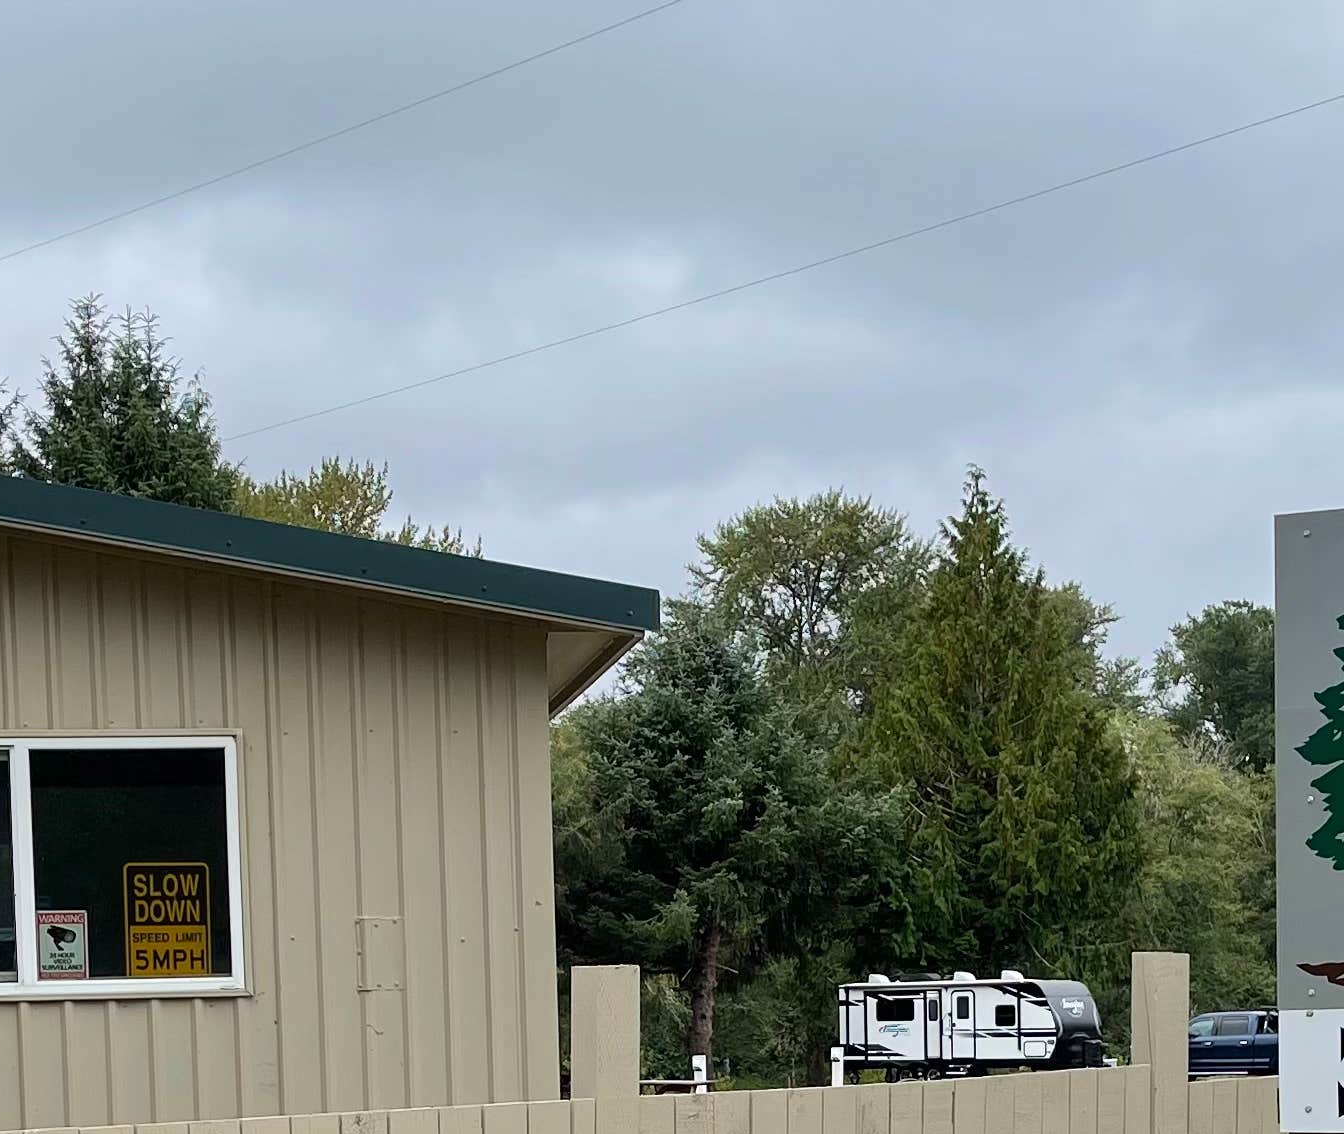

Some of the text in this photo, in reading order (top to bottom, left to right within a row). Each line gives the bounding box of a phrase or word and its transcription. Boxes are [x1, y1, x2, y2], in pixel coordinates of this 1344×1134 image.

[133, 873, 200, 897] SLOW
[38, 913, 85, 923] WARNING
[135, 899, 201, 923] DOWN
[132, 931, 203, 943] SPEED LIMIT
